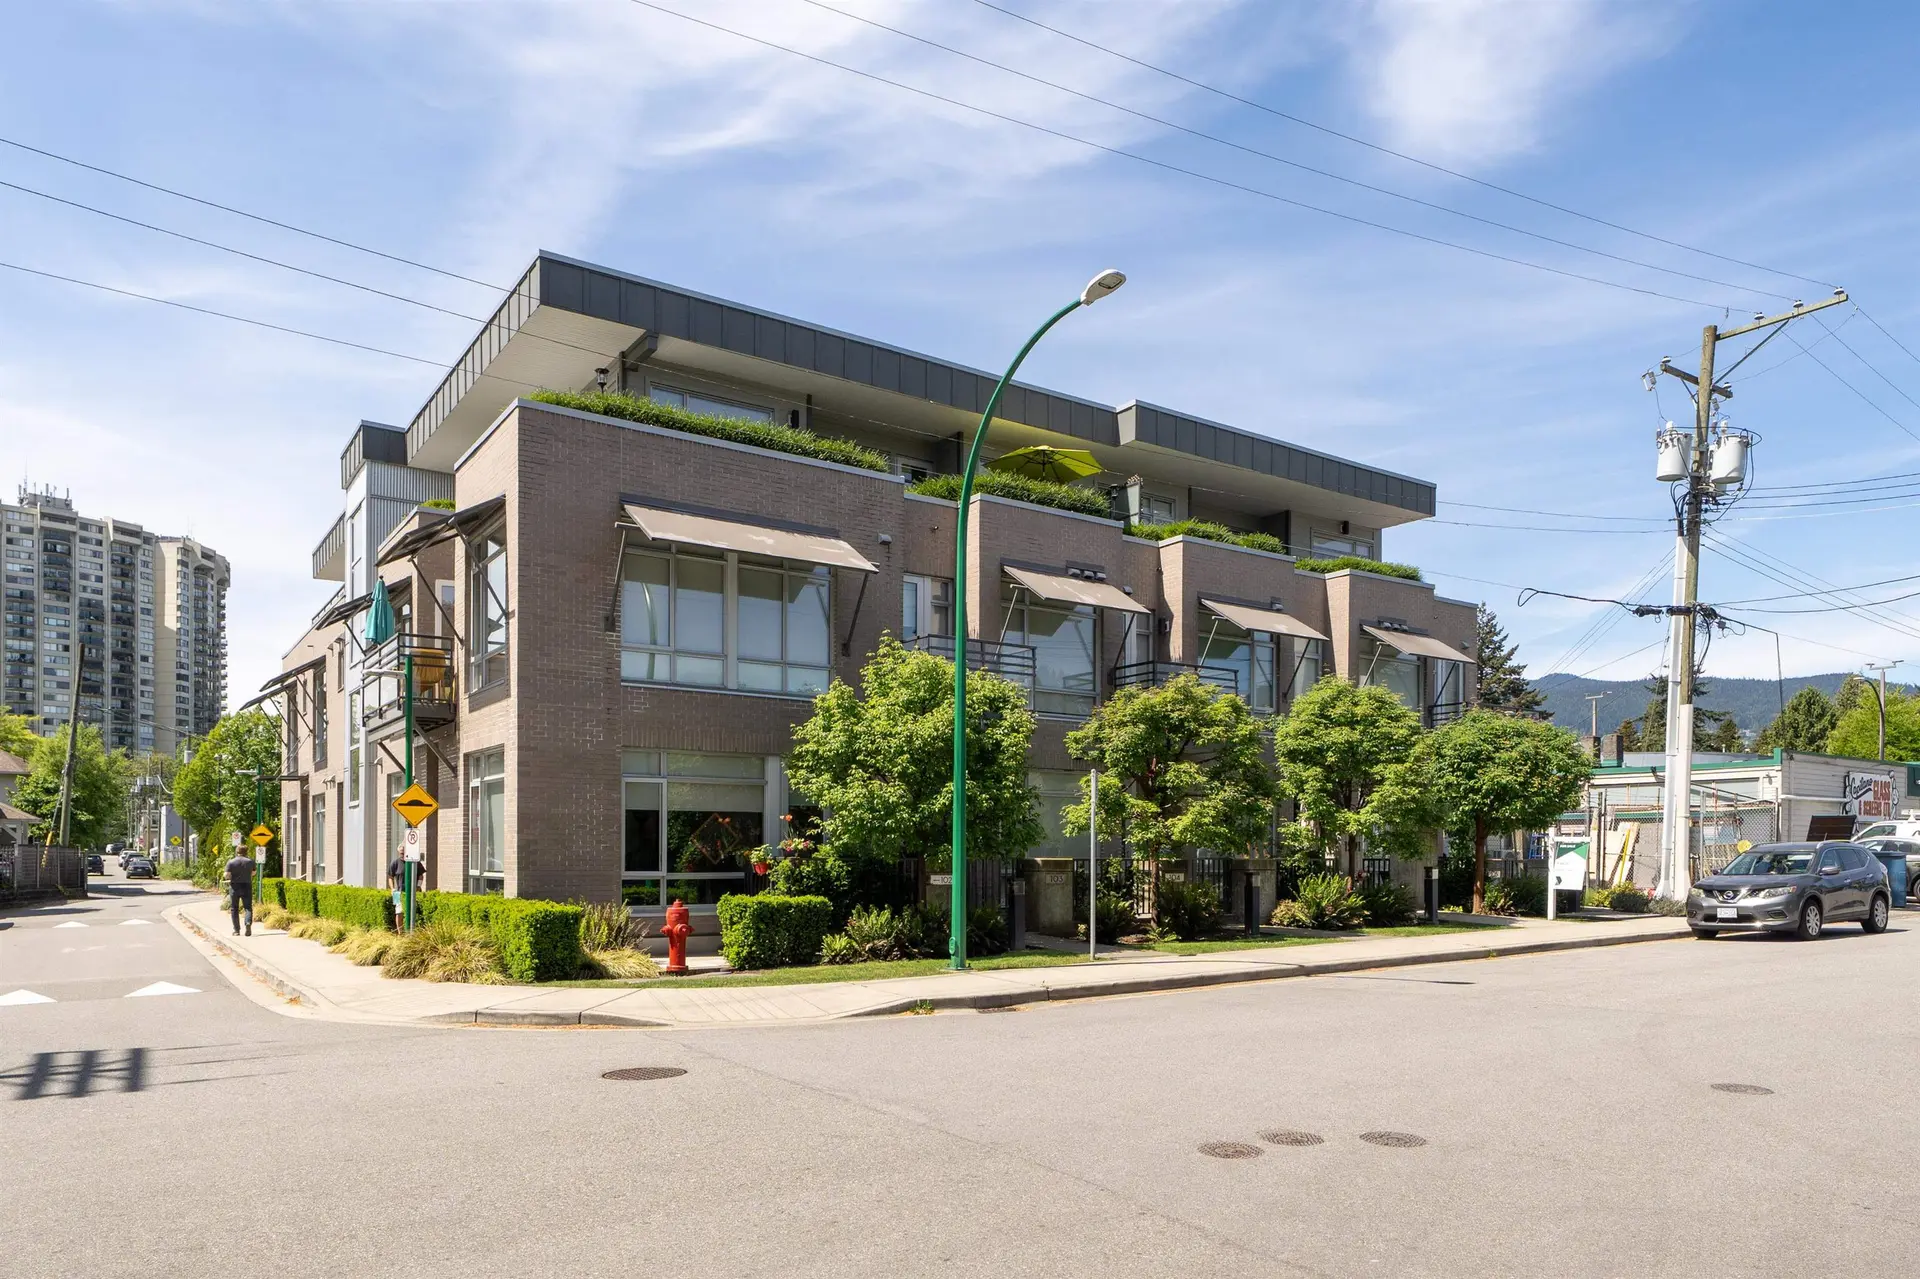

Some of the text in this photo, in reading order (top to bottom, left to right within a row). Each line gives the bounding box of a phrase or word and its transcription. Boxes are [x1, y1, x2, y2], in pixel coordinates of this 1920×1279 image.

[1873, 780, 1890, 801] GLASS
[1863, 800, 1882, 816] SCREENS
[941, 876, 952, 884] 102
[1050, 875, 1063, 883] 103
